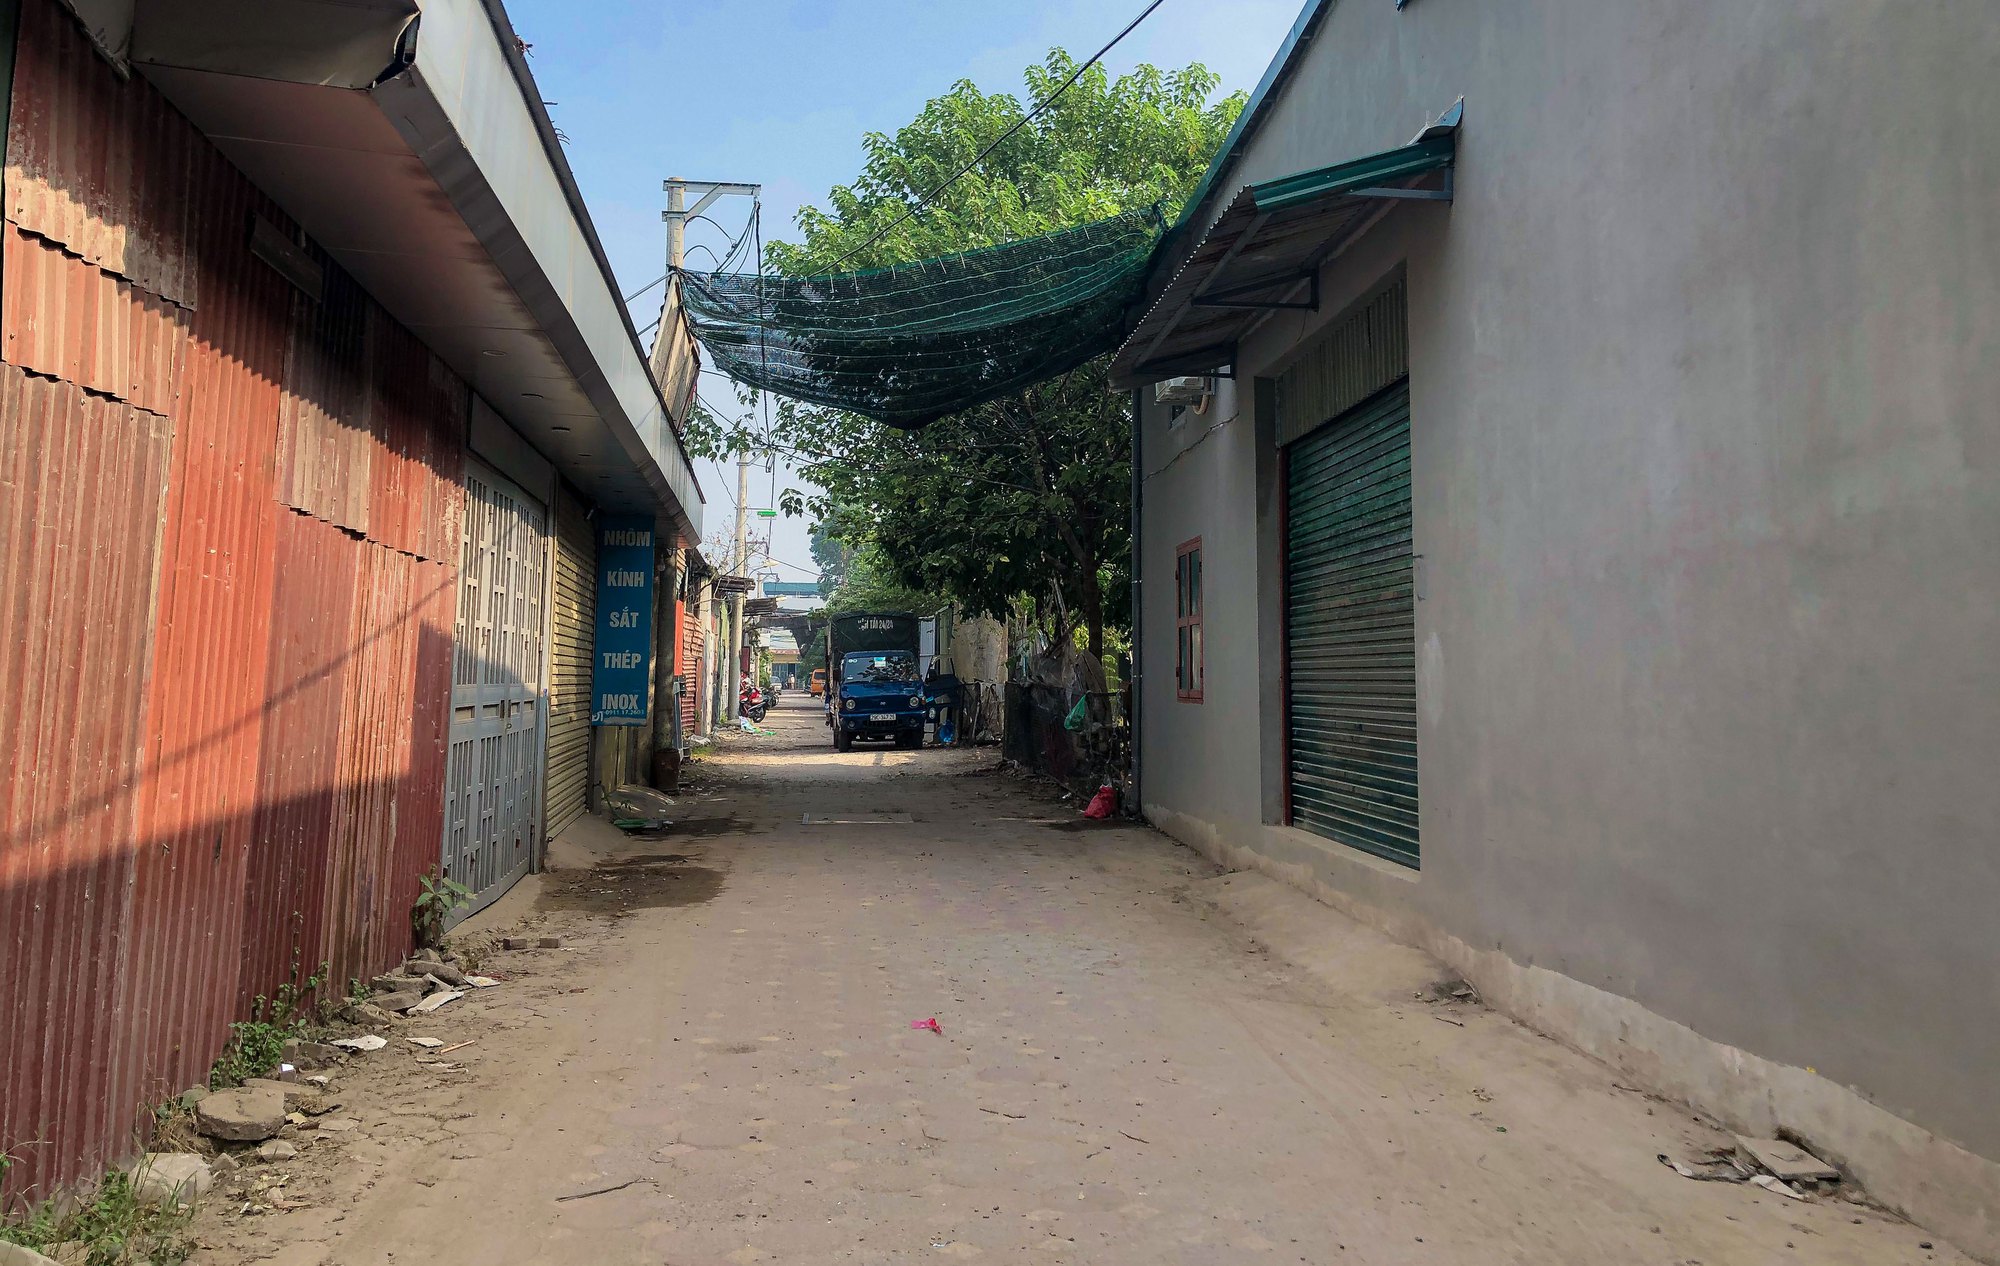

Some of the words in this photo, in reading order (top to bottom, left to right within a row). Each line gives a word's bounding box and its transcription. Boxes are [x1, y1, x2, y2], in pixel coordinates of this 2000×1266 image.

[603, 528, 651, 547] NHÔM
[607, 568, 645, 587] KÍNH
[609, 606, 639, 628] SẮT
[602, 649, 642, 669] THÉP
[601, 693, 639, 710] INOX
